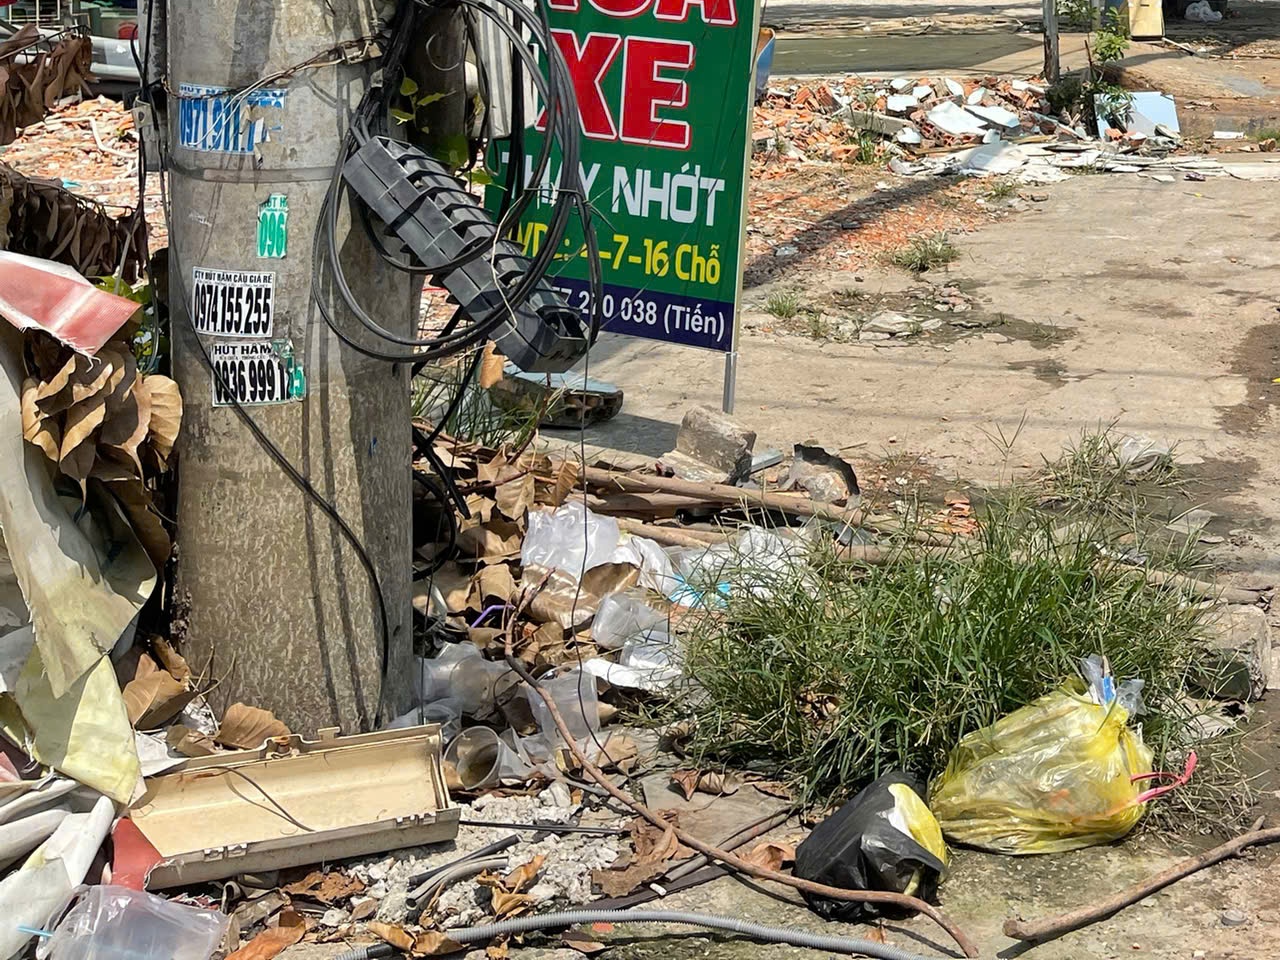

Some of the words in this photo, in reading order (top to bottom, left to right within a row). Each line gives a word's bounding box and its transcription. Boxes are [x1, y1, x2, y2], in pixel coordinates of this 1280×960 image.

[535, 27, 696, 151] XE
[611, 161, 725, 227] NHỚT
[675, 243, 721, 285] Chỗ
[194, 282, 271, 334] 0974.155.255
[620, 296, 658, 325] 038
[664, 303, 726, 342] (Tiến)
